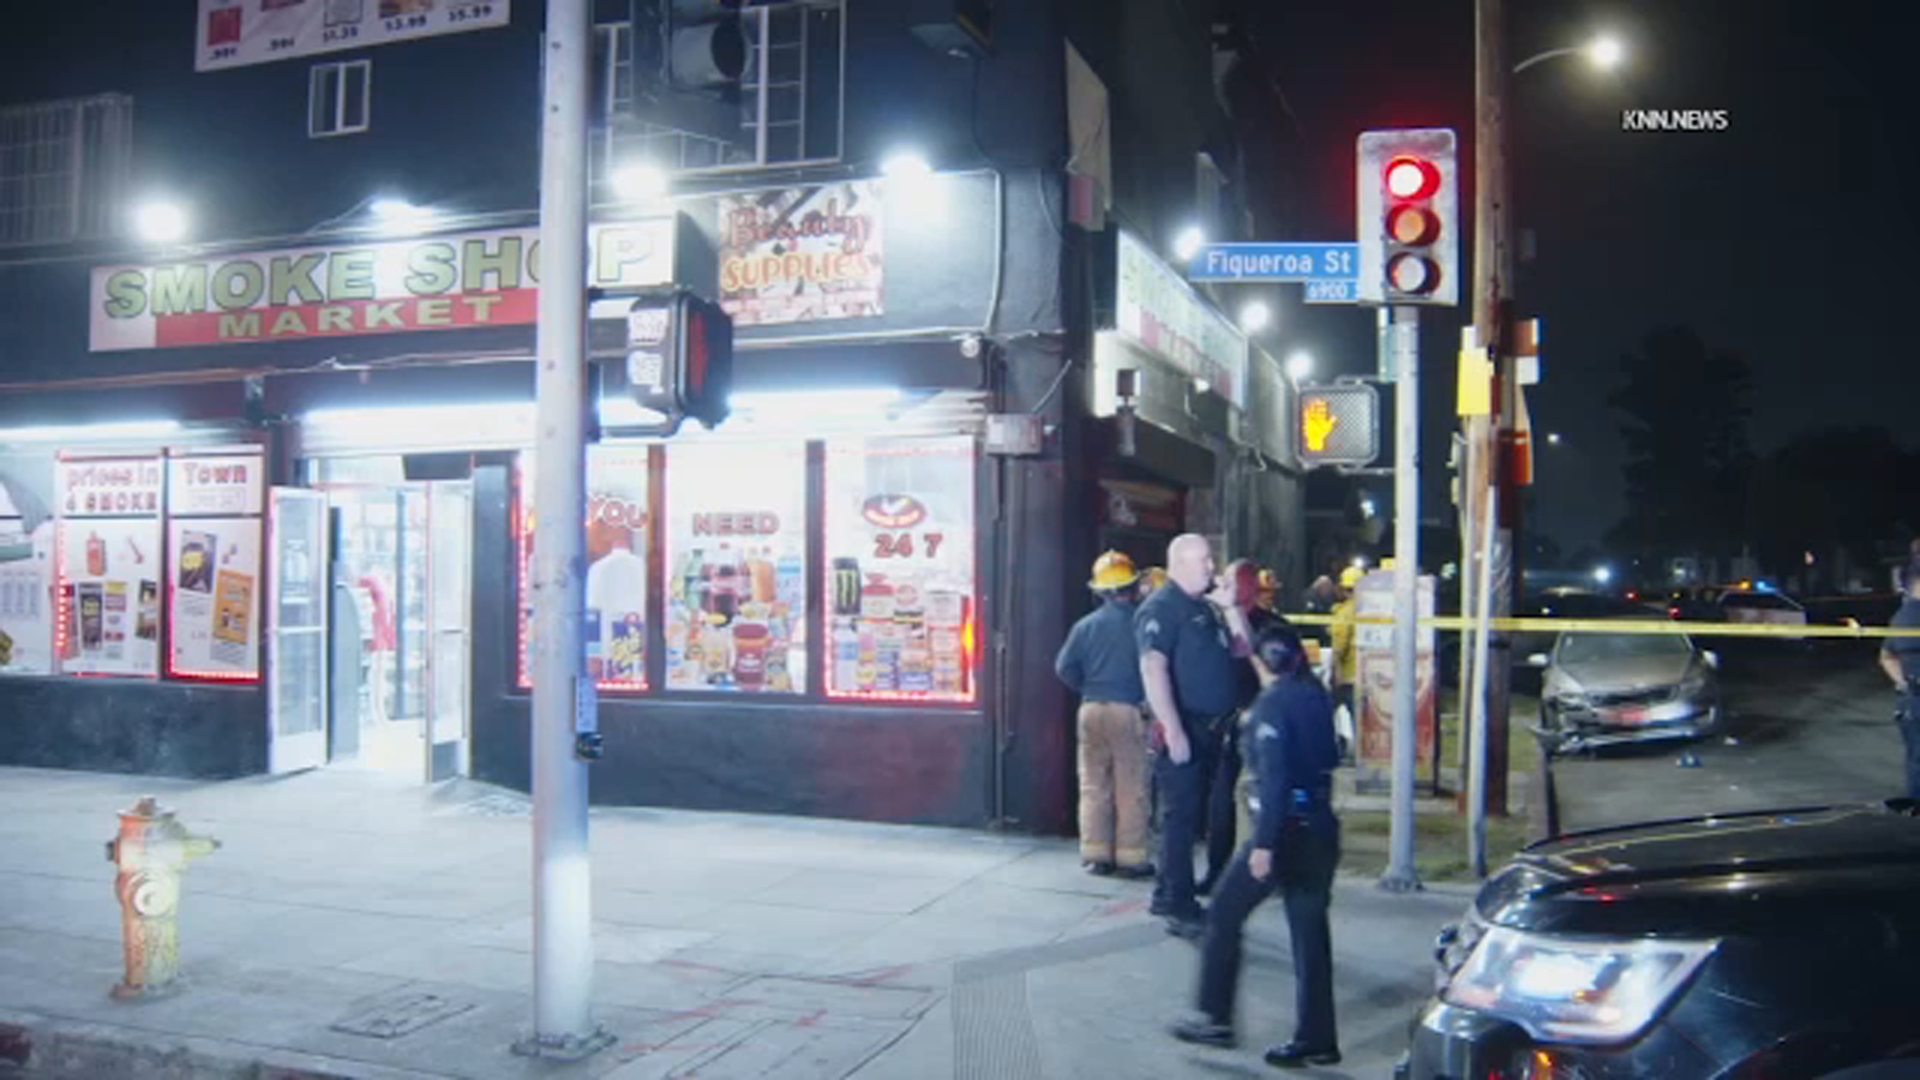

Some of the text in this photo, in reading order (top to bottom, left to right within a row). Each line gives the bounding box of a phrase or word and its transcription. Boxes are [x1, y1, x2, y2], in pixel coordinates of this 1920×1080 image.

[104, 228, 654, 318] SMOKE SHP
[721, 252, 871, 292] SUPPLIES
[1206, 249, 1351, 278] Figueroa St
[1309, 282, 1348, 299] 6900
[216, 296, 501, 339] MARKET
[183, 463, 247, 485] Town
[85, 491, 156, 511] SMOKE
[693, 511, 779, 536] NEED
[873, 533, 913, 558] 24
